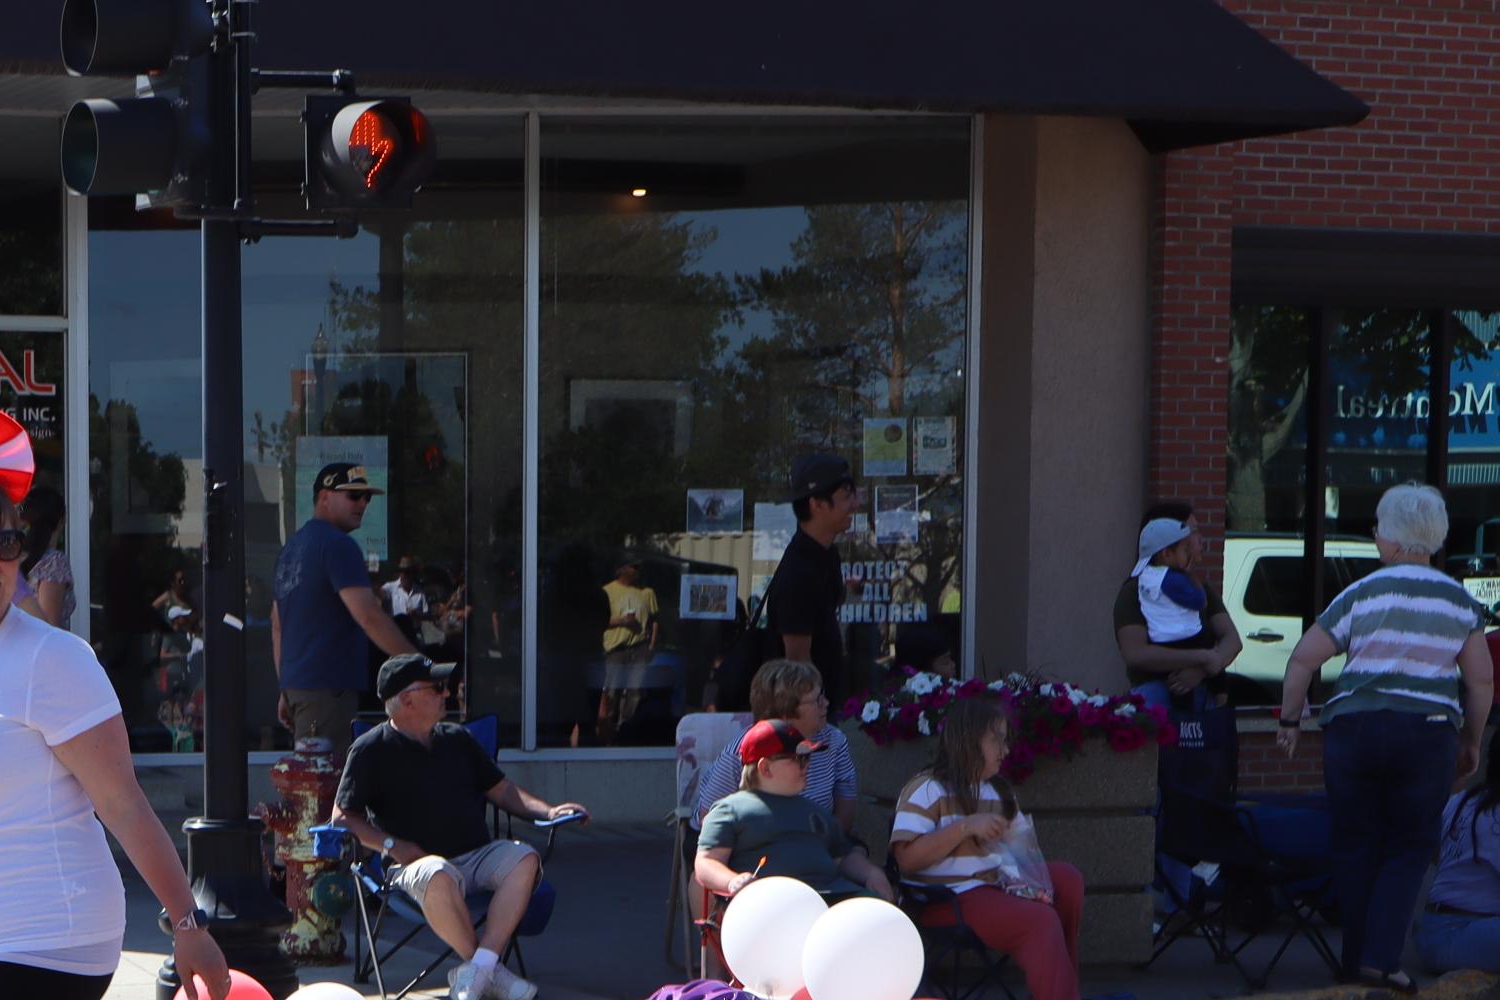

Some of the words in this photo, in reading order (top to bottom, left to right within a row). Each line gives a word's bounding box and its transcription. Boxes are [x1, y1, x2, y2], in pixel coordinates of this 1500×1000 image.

[23, 407, 56, 422] INC.
[840, 561, 907, 580] ROTECT
[862, 582, 891, 601] ALL
